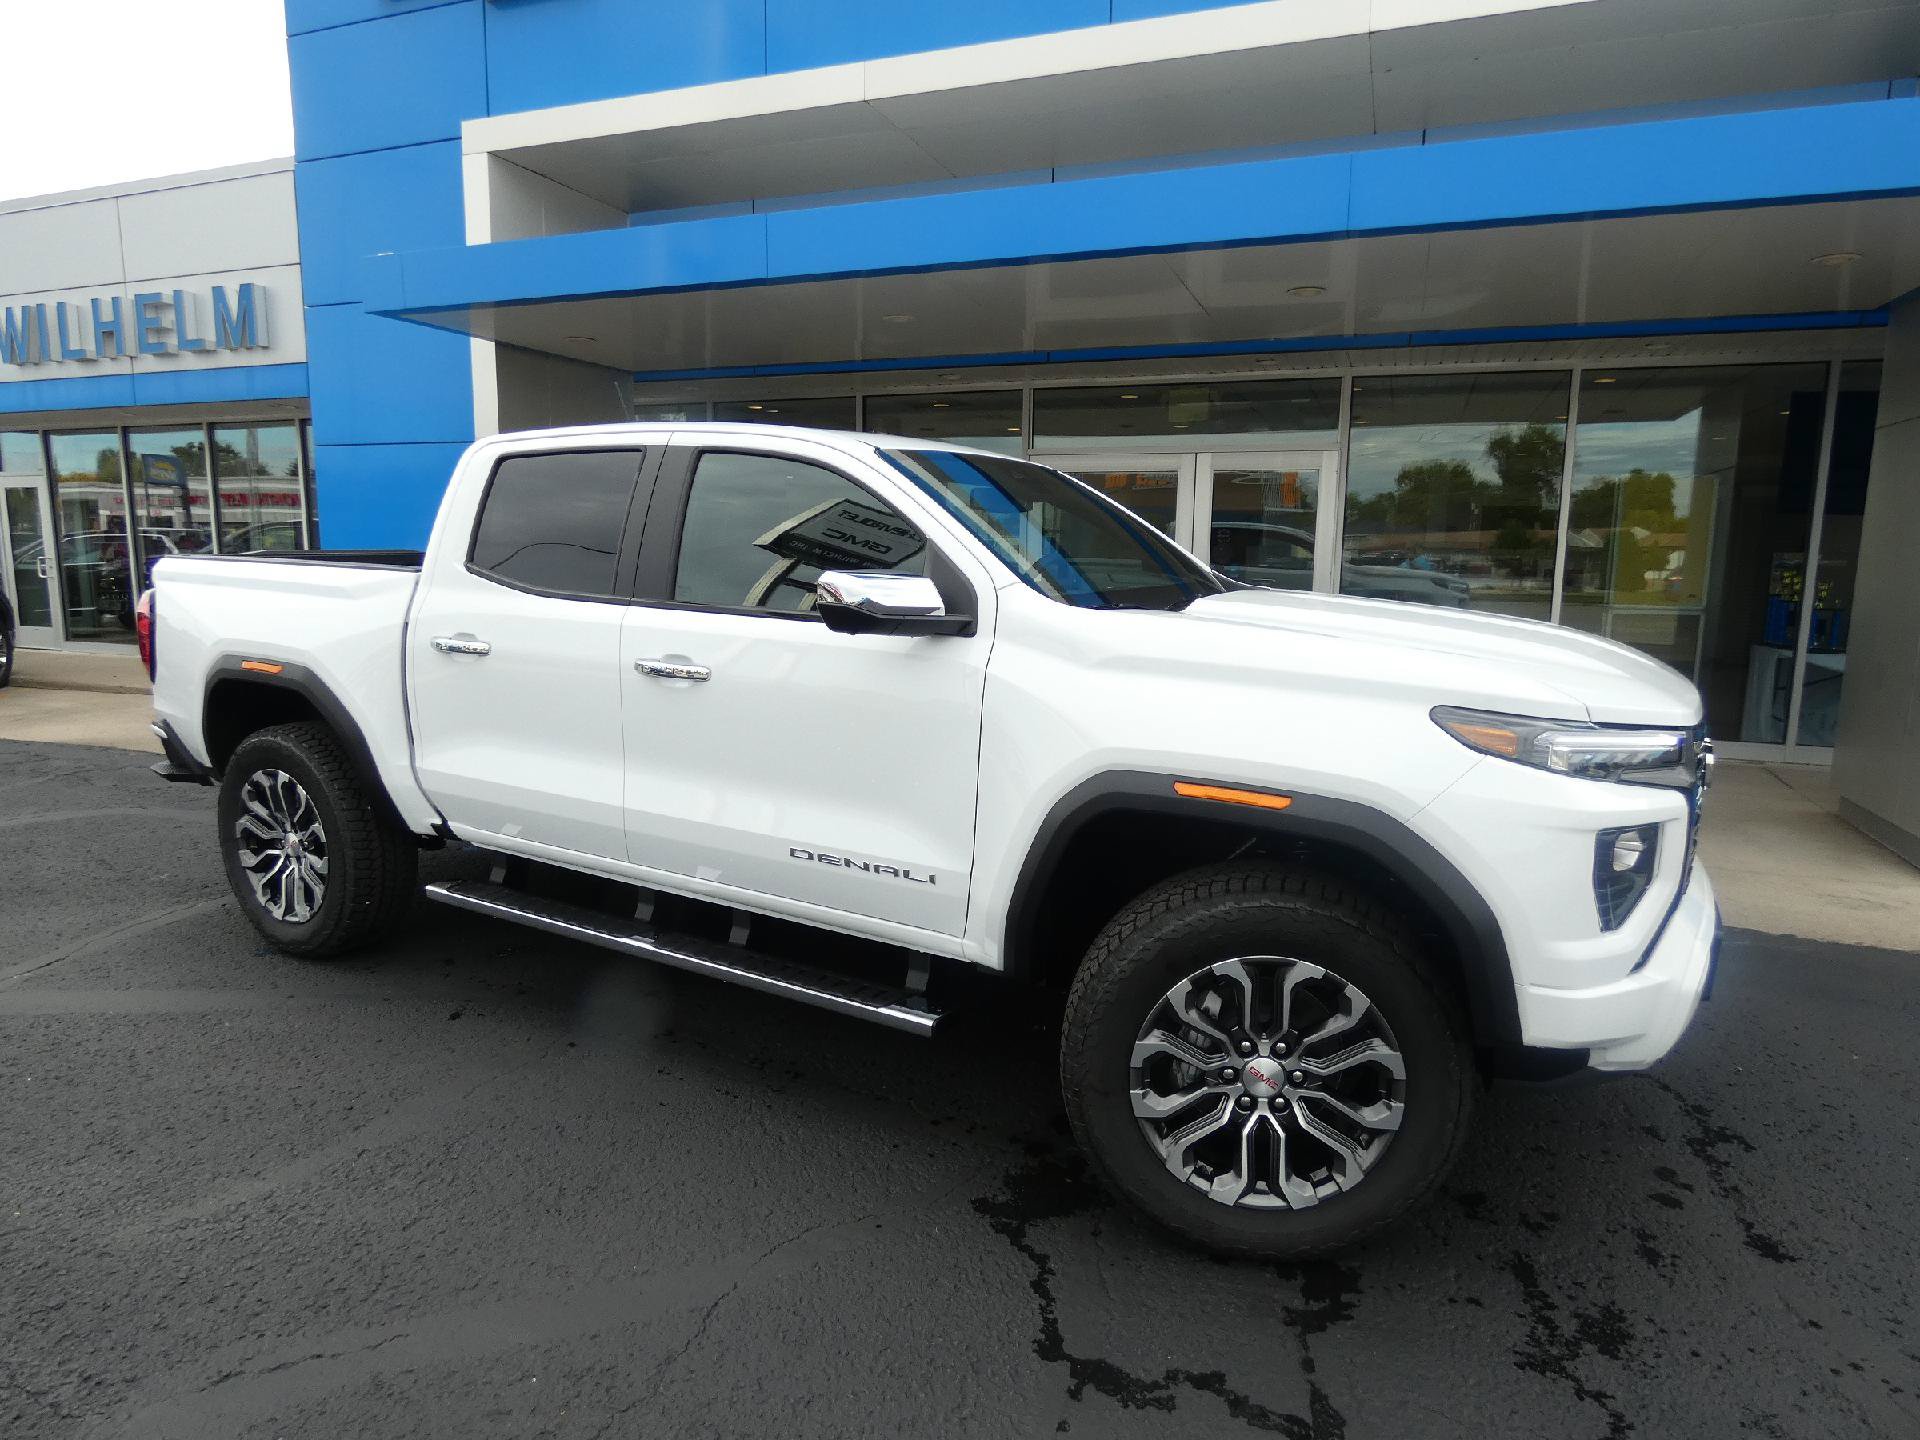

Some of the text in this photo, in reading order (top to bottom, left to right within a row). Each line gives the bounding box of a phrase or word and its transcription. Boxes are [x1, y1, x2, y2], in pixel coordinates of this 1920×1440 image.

[0, 283, 258, 366] WILHELM
[789, 846, 937, 886] DENALI
[1248, 1066, 1279, 1091] GMC
